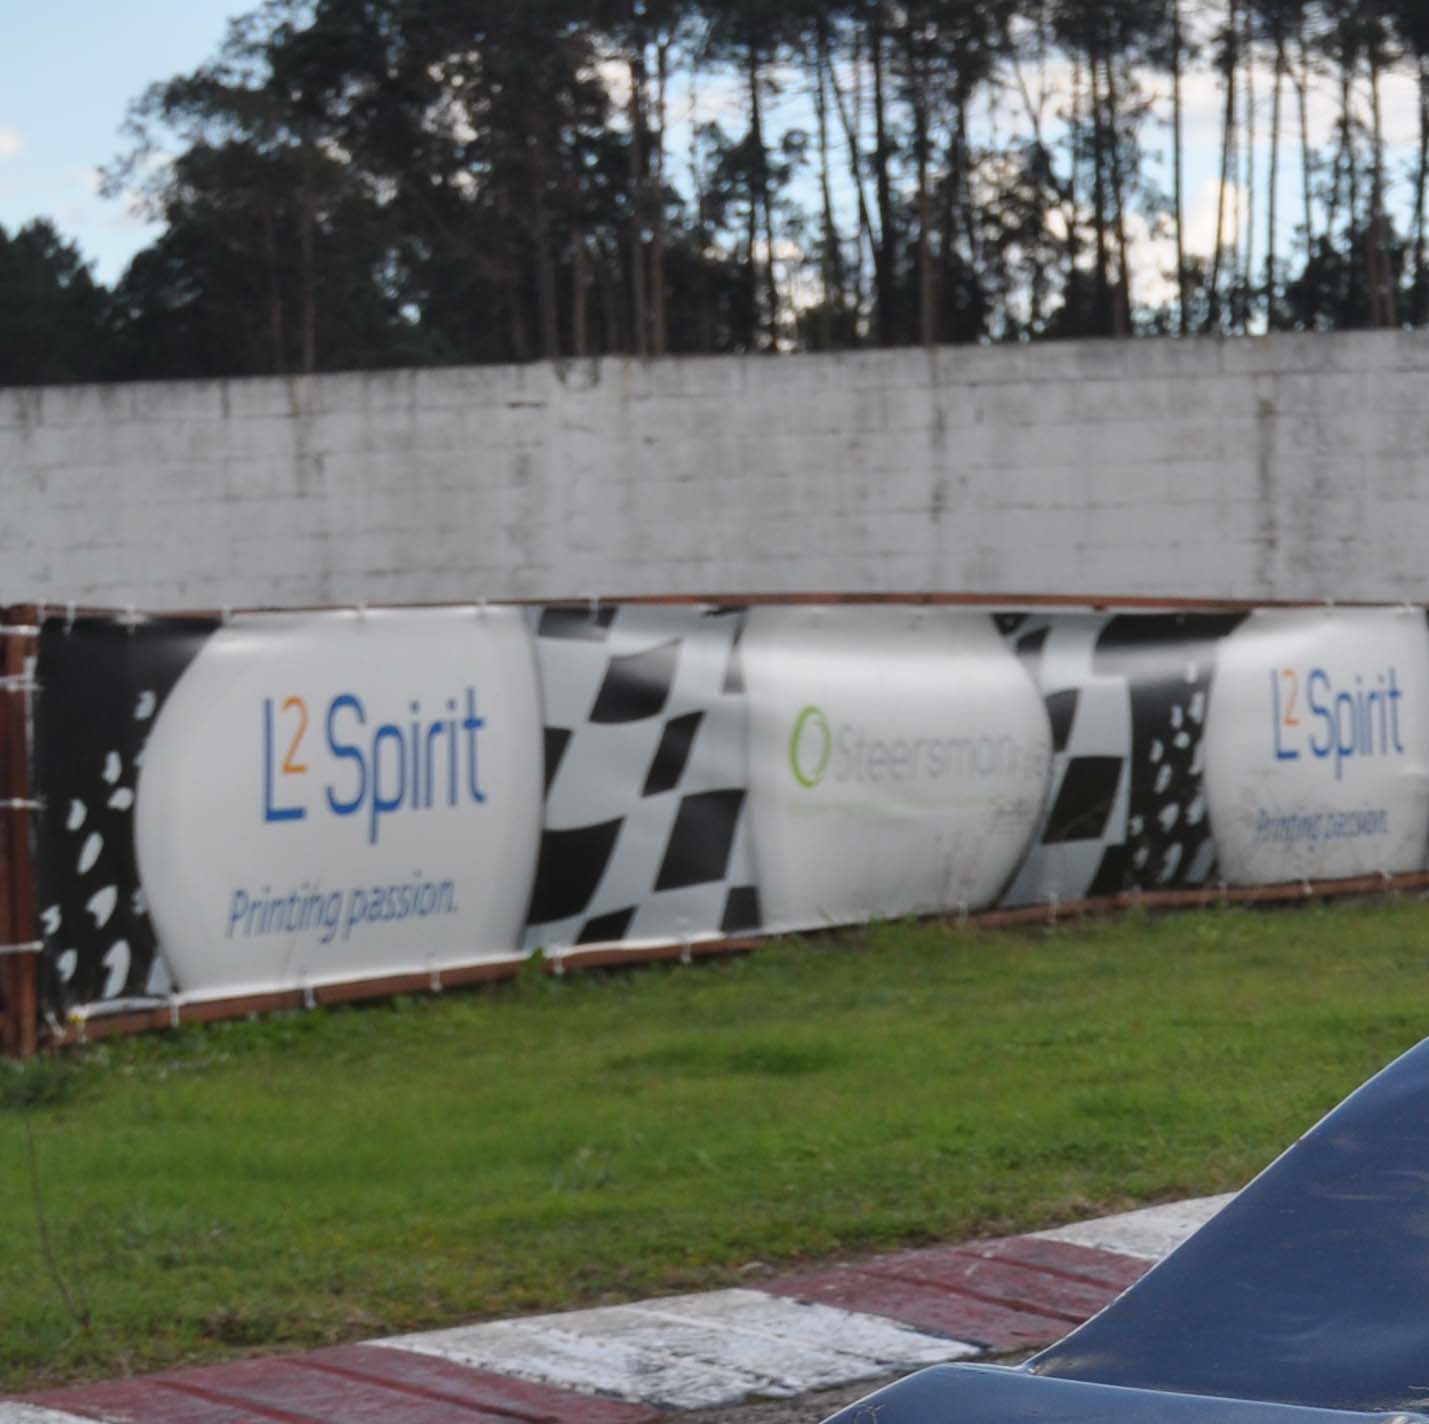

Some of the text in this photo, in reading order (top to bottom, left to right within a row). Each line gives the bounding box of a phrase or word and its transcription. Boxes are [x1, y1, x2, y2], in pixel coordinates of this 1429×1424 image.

[325, 686, 487, 845] Spirit
[1307, 667, 1404, 780] Spirit
[227, 885, 344, 944] Printing
